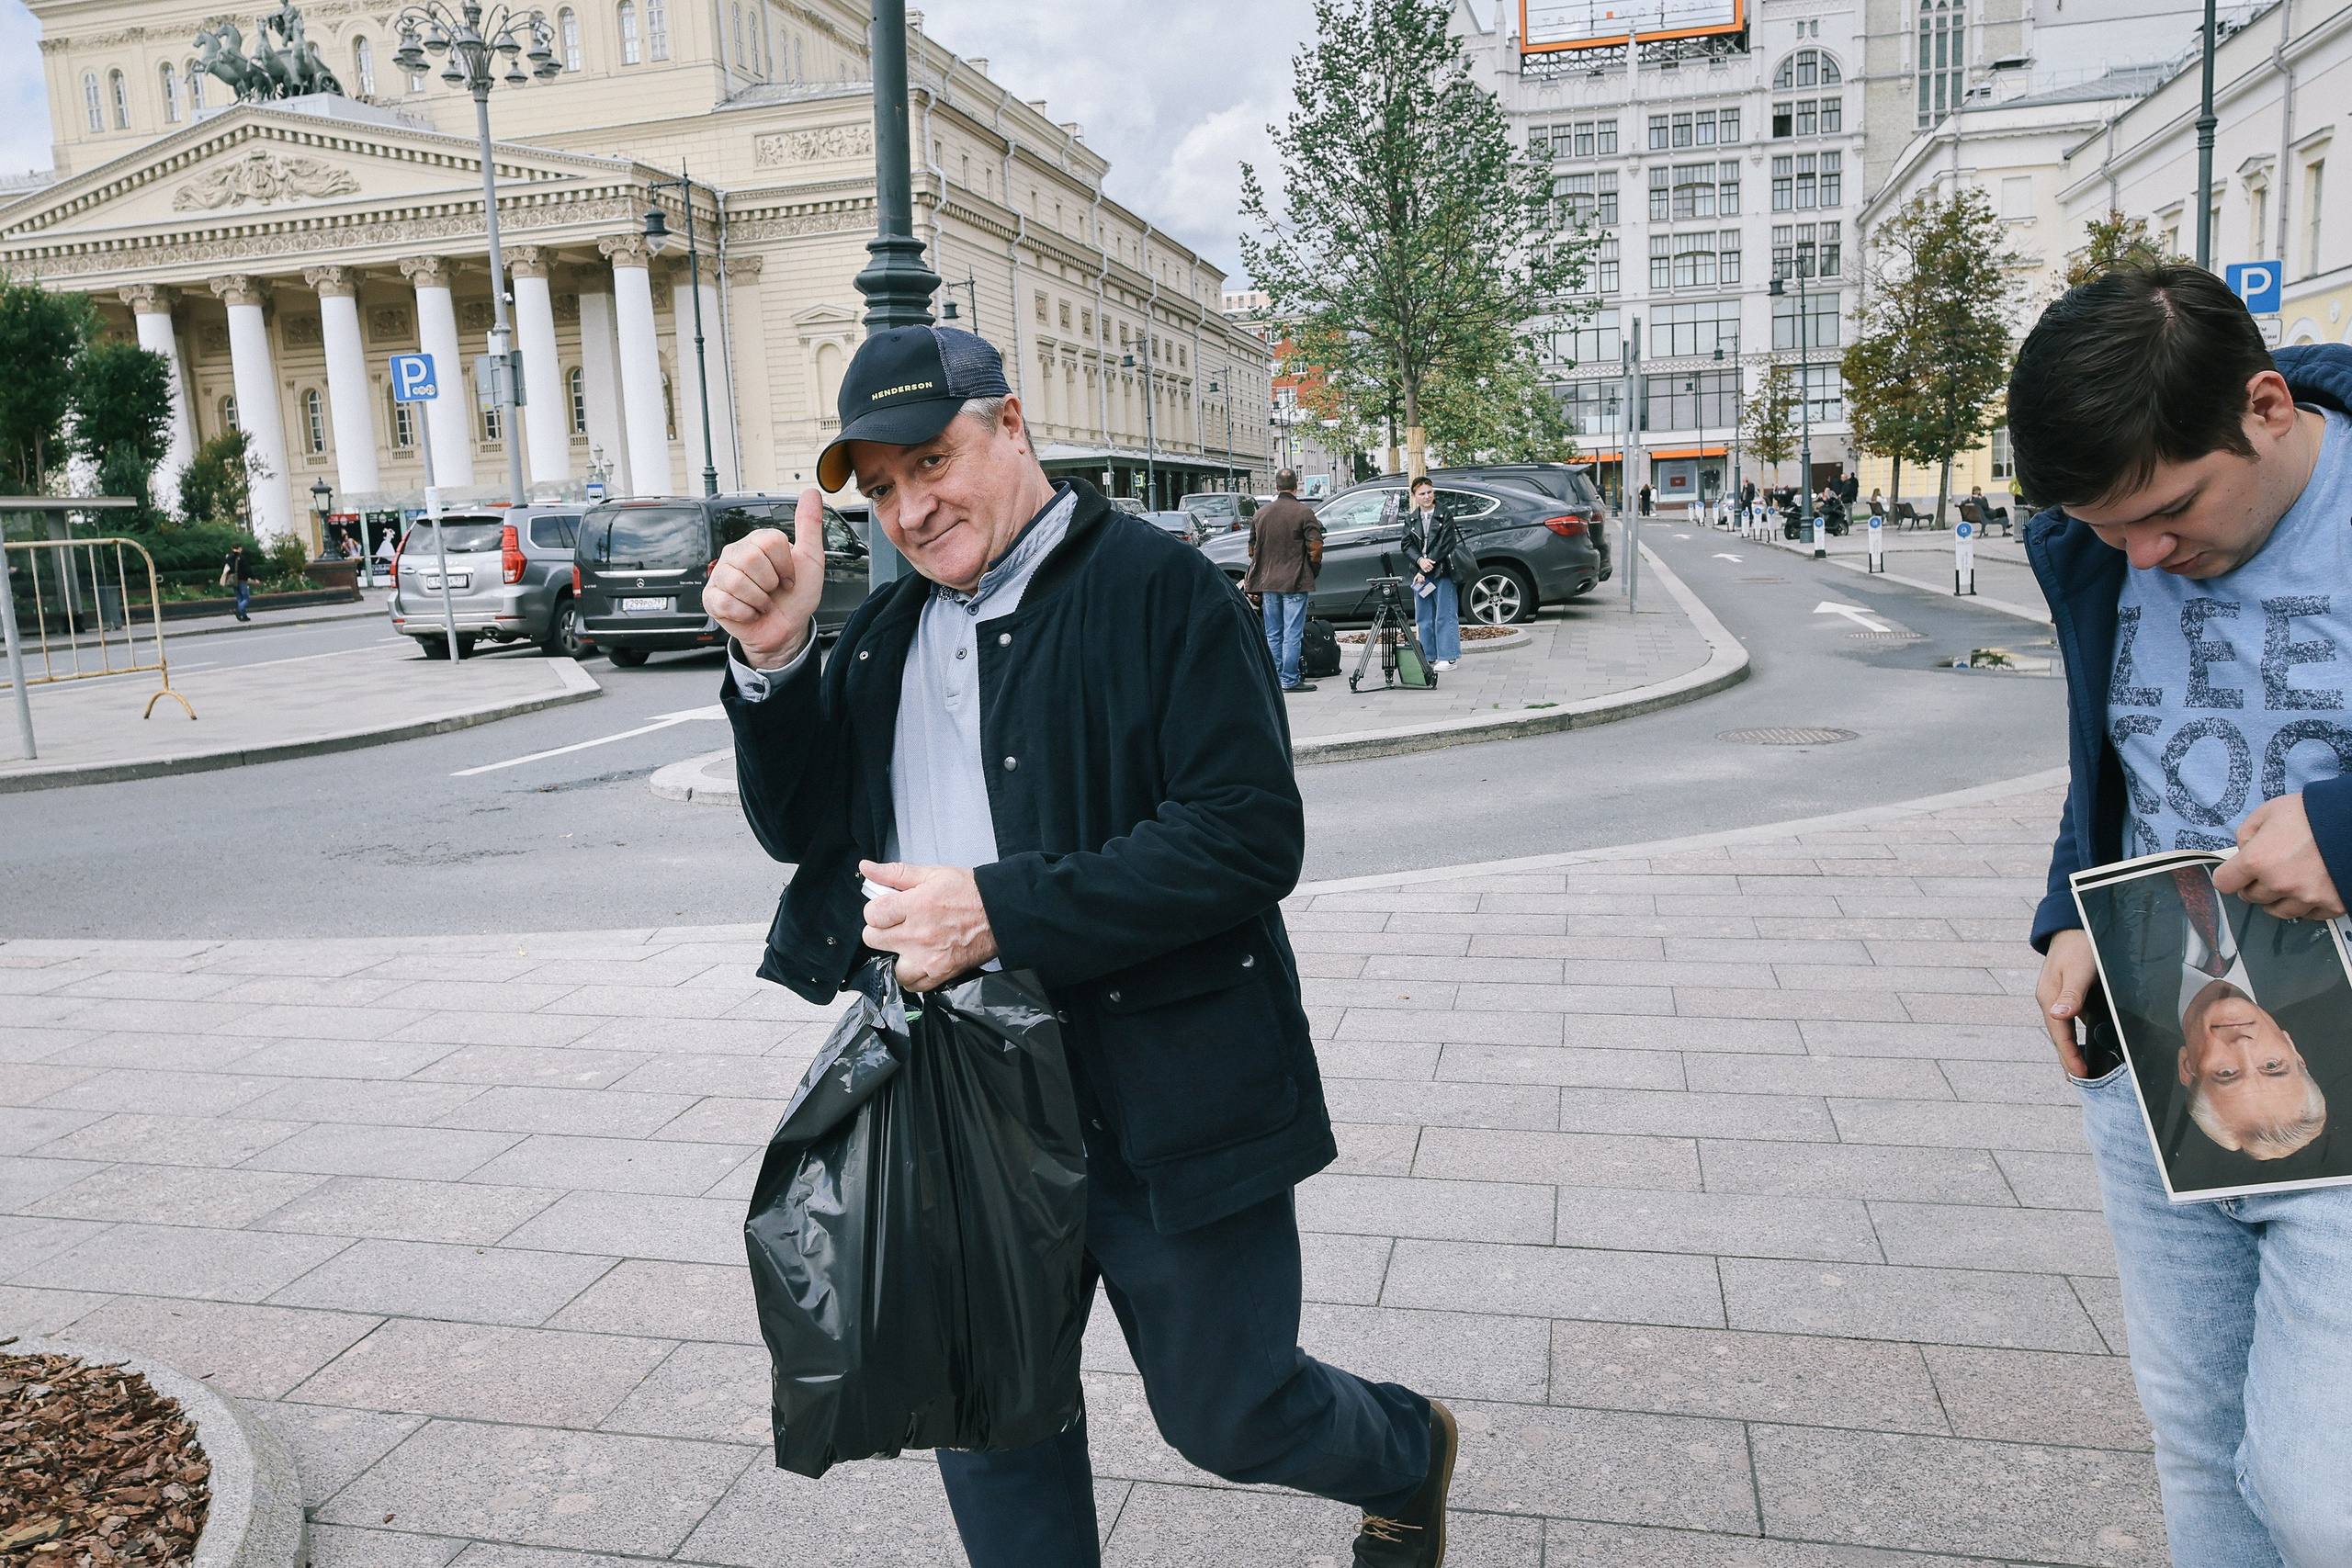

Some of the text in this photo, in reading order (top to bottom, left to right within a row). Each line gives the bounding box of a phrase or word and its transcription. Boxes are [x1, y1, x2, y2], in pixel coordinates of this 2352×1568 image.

[2240, 266, 2273, 310] P
[400, 357, 427, 398] P
[871, 381, 933, 400] HENDERSON
[2109, 595, 2345, 711] LEE
